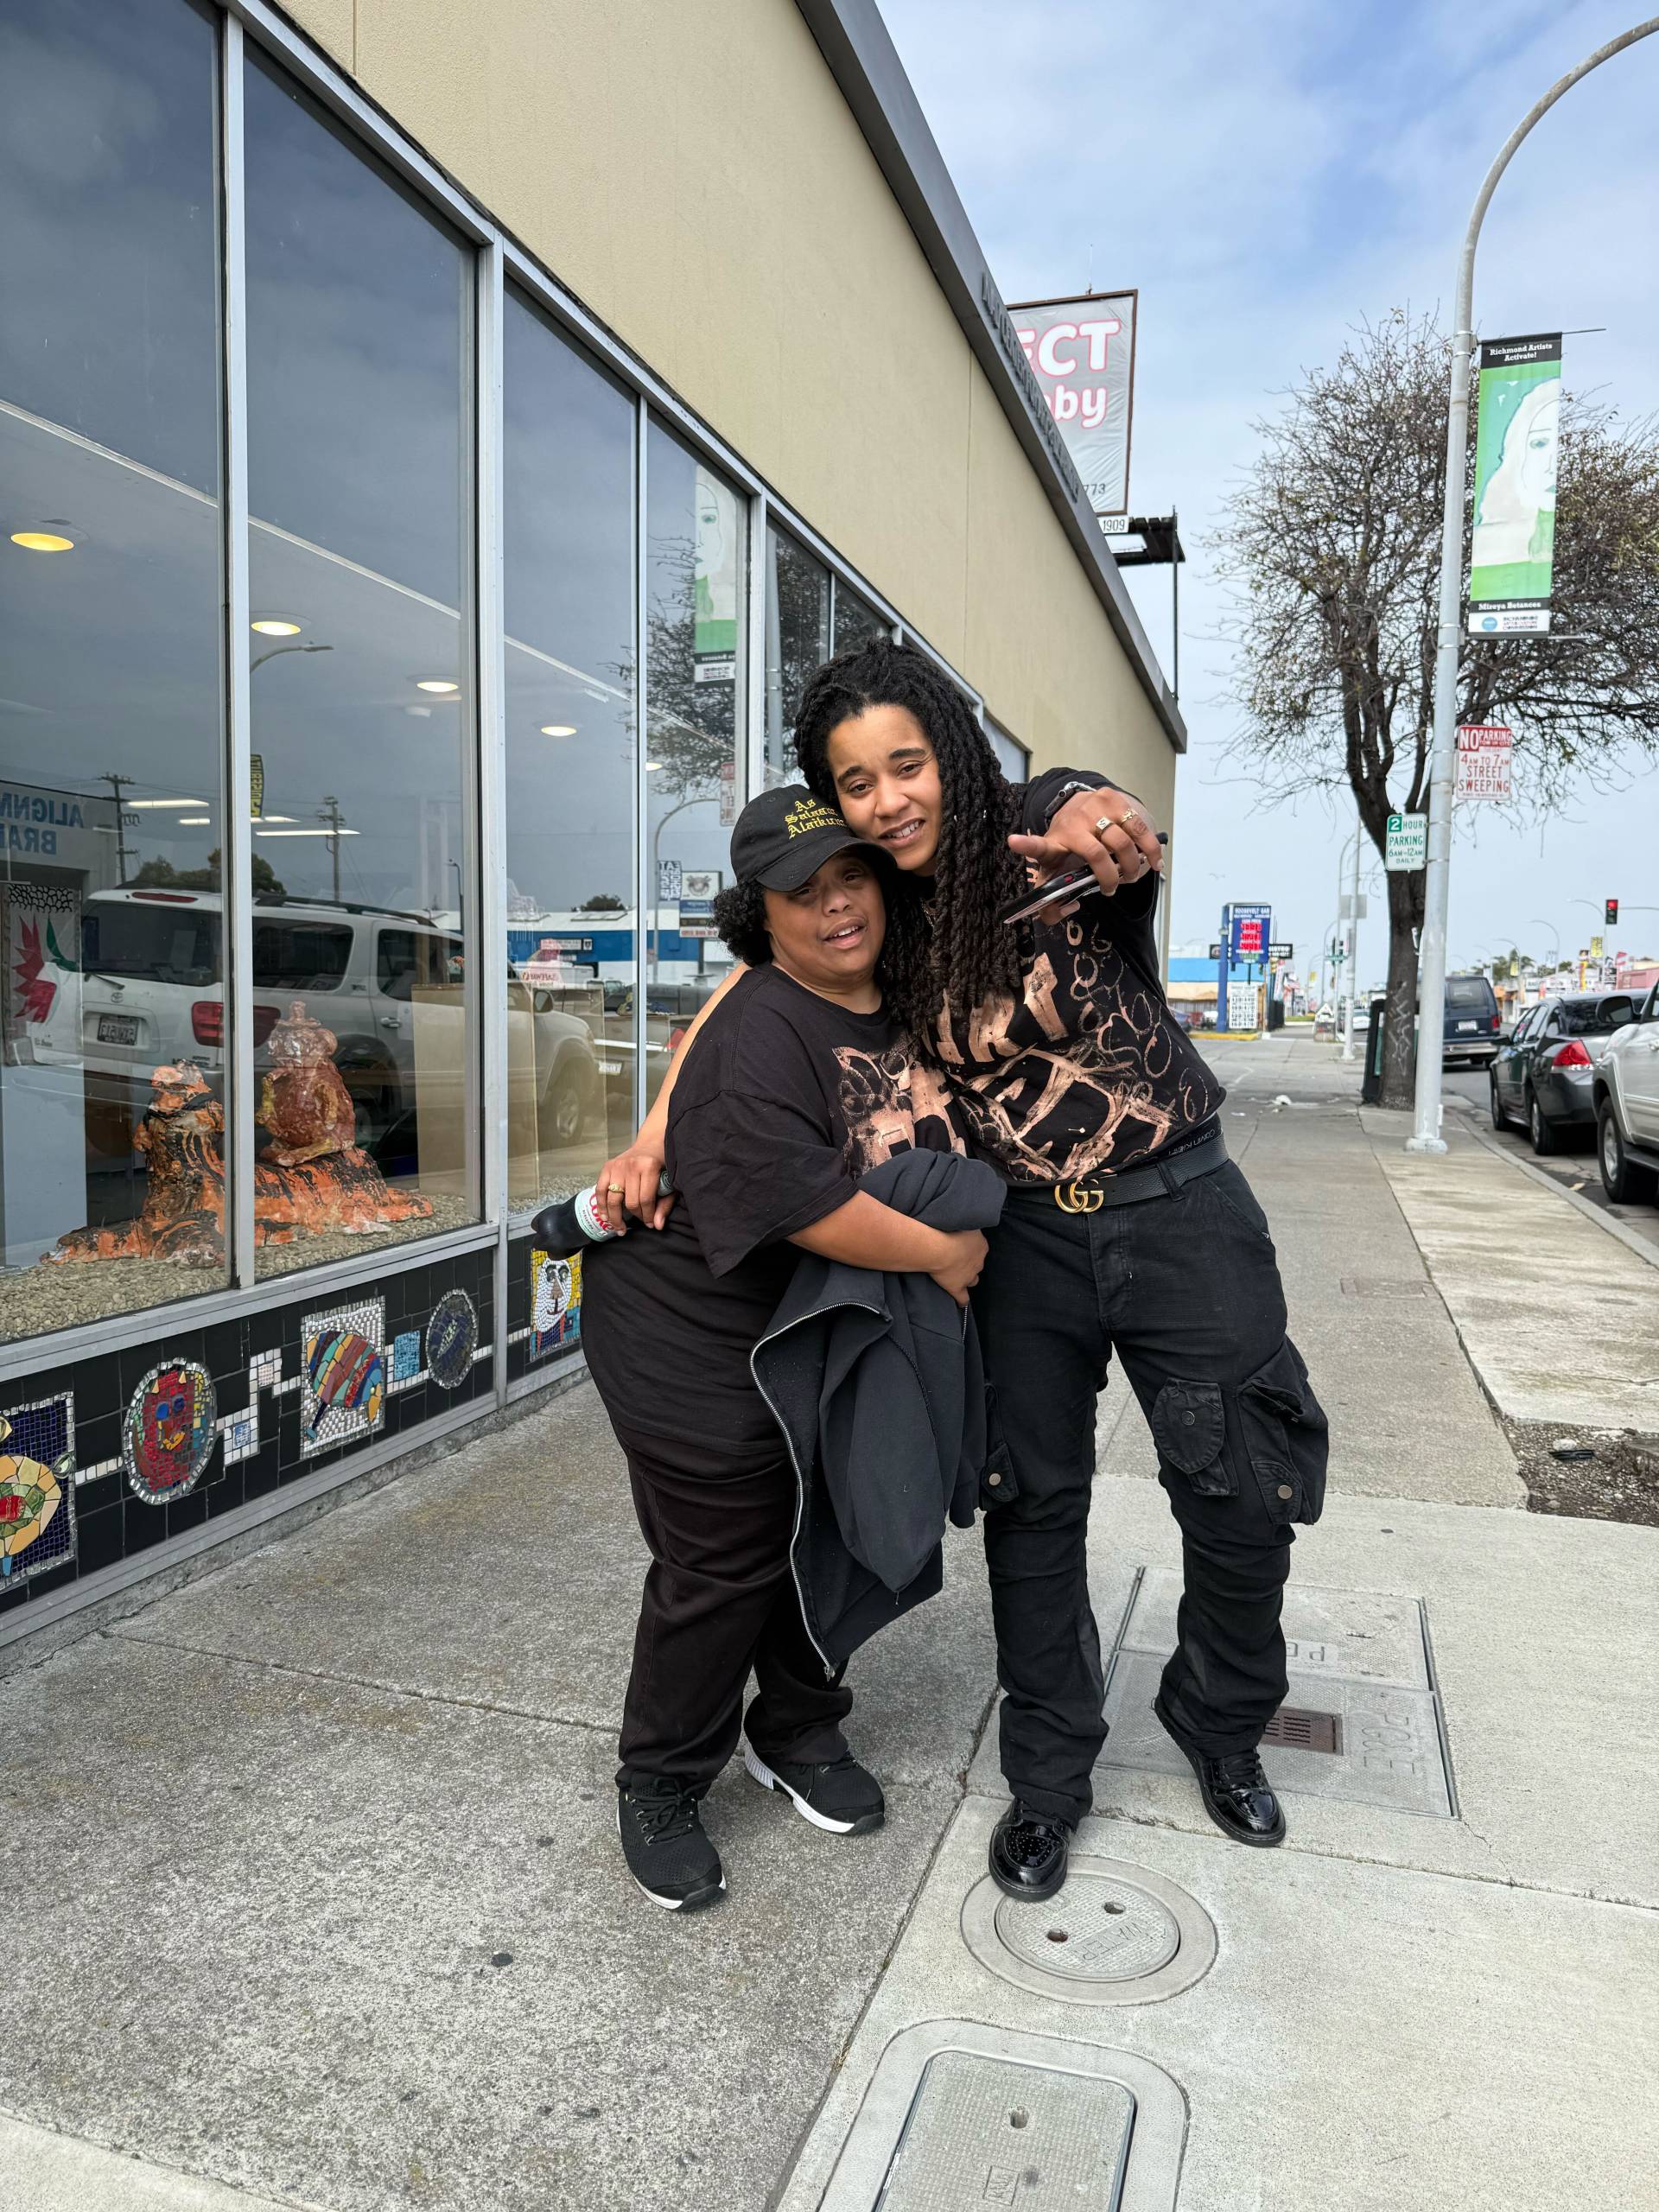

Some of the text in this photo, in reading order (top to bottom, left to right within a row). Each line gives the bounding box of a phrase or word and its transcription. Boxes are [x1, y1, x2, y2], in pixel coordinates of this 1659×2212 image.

[1490, 342, 1553, 356] Richmond Artists
[1504, 352, 1536, 362] Activate!
[1103, 519, 1125, 531] 1909
[1478, 602, 1506, 611] Mireya
[1459, 728, 1511, 750] NO PARKING
[1460, 753, 1510, 766] 4AM TO 7AM
[1466, 766, 1503, 779] STREET
[1459, 779, 1510, 793] SWEEPING
[1390, 817, 1424, 830] 2 HOUR
[1389, 836, 1424, 847] PARKING
[1081, 1919, 1147, 1961] WATER
